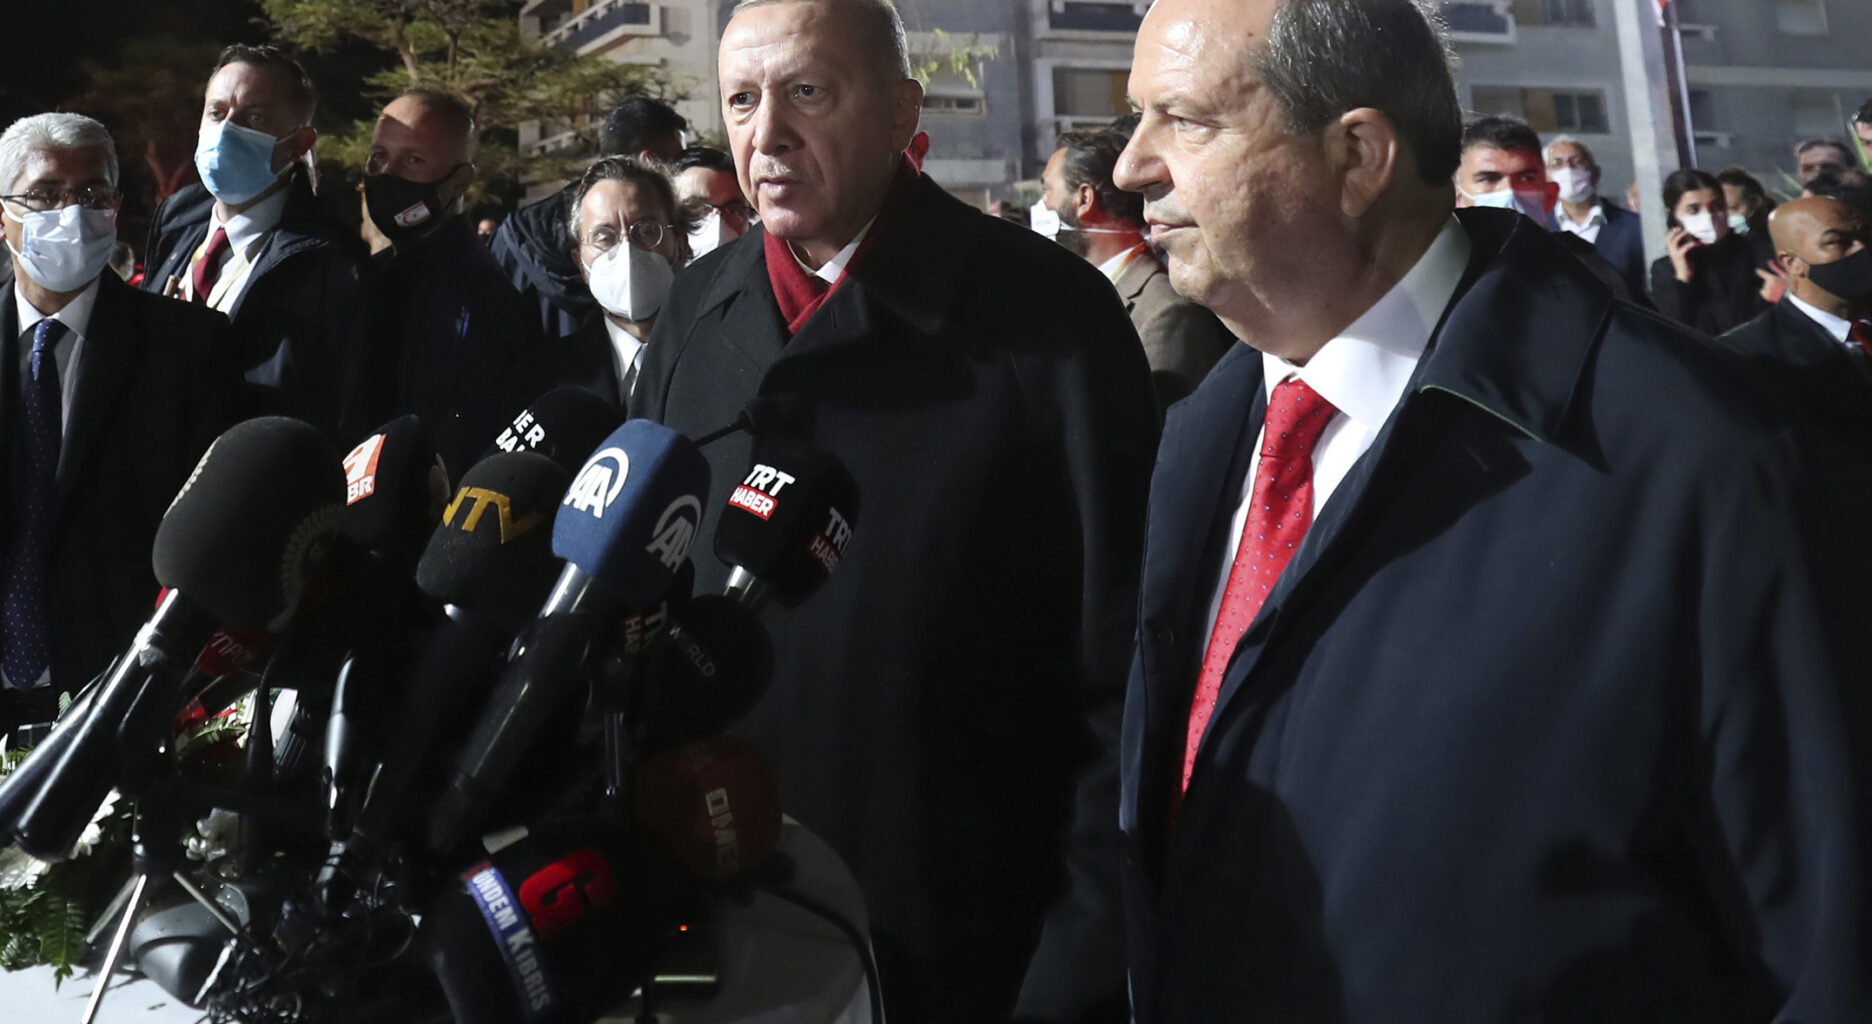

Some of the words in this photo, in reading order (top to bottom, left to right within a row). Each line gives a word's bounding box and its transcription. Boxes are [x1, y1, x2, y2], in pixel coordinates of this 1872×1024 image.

[563, 461, 615, 519] AA
[743, 463, 796, 497] TRT
[730, 487, 775, 517] HABER
